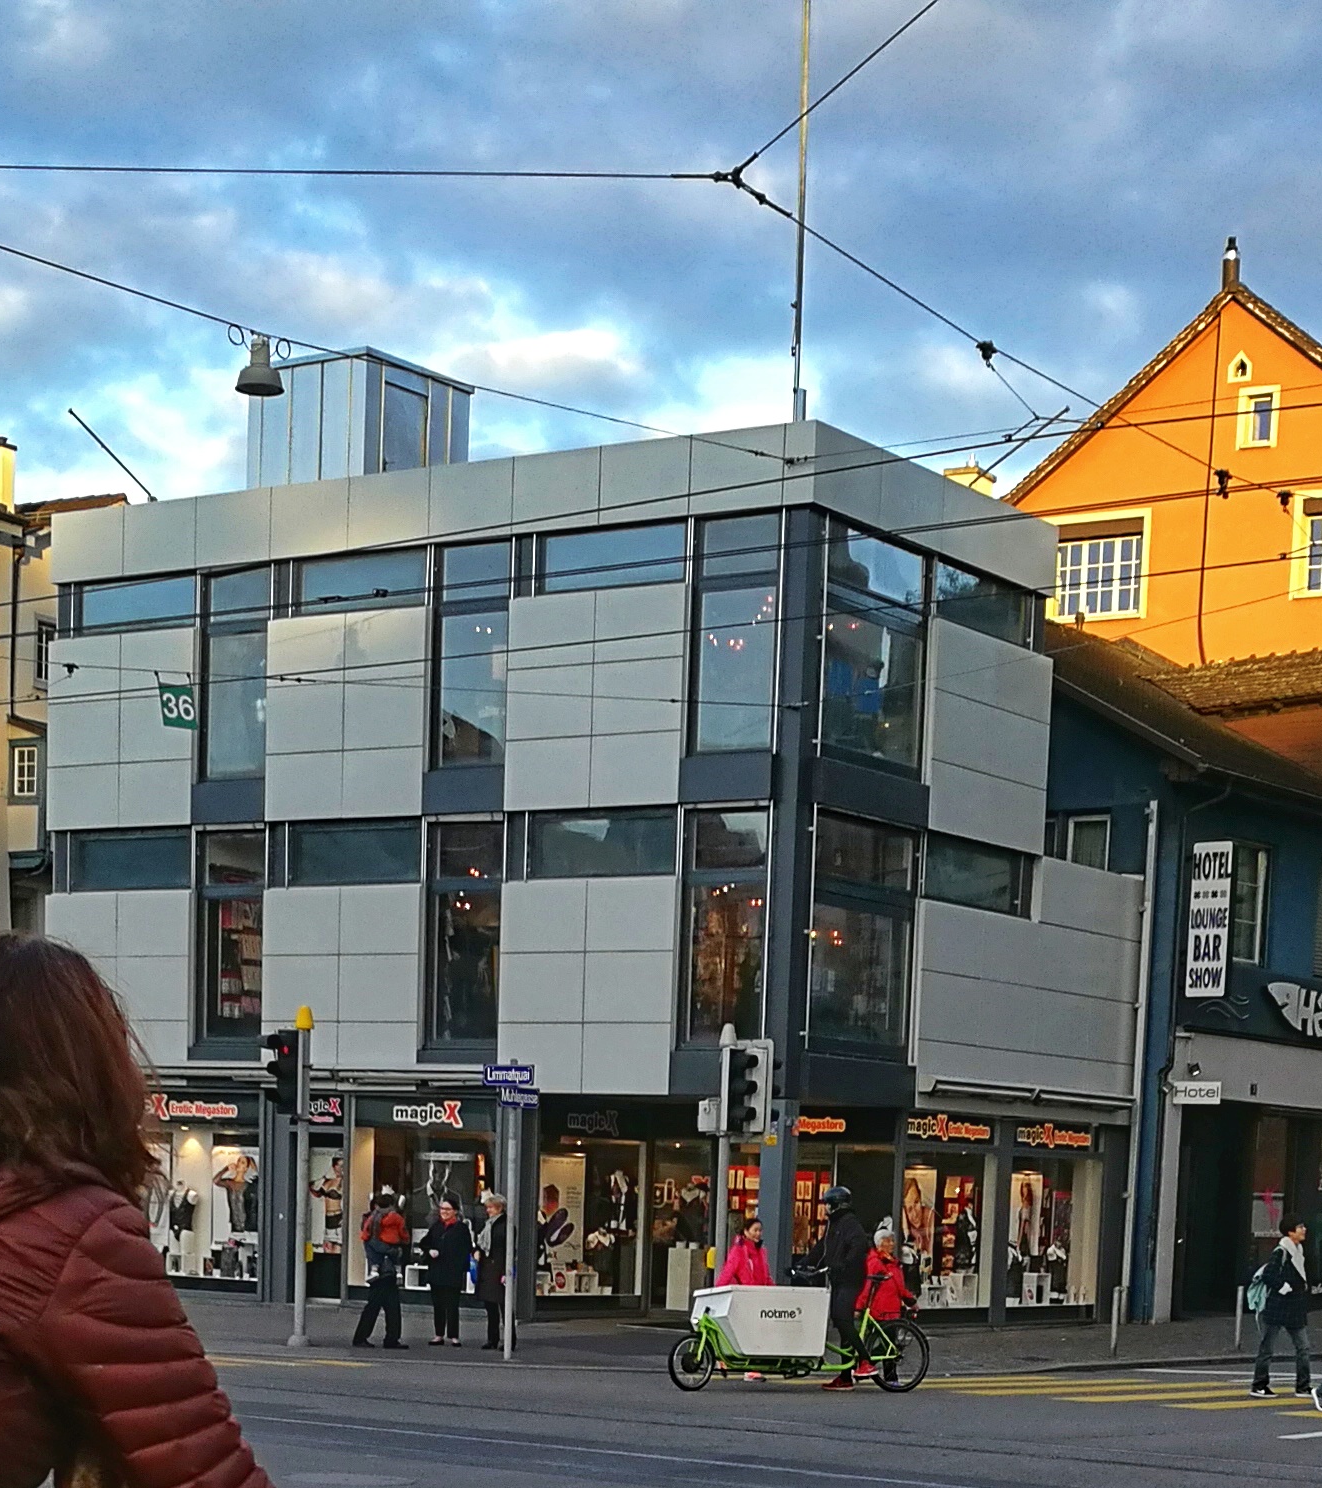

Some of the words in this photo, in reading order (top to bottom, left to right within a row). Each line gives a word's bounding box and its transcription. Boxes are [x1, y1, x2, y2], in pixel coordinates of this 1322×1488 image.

[162, 693, 195, 721] 36
[1193, 851, 1232, 880] HOTEL
[1190, 907, 1228, 930] LOUNGE
[1192, 934, 1222, 962] BAR
[1188, 966, 1223, 989] SHOW
[487, 1066, 530, 1084] Limmatquai
[1175, 1085, 1221, 1100] Hotel
[169, 1102, 193, 1116] Erotic
[195, 1102, 238, 1119] Megastore
[393, 1100, 463, 1128] magicX
[567, 1111, 619, 1137] magicX
[798, 1115, 846, 1134] Megastore
[907, 1114, 948, 1141] magicX
[1017, 1123, 1054, 1148] magicX
[760, 1308, 797, 1319] notime
